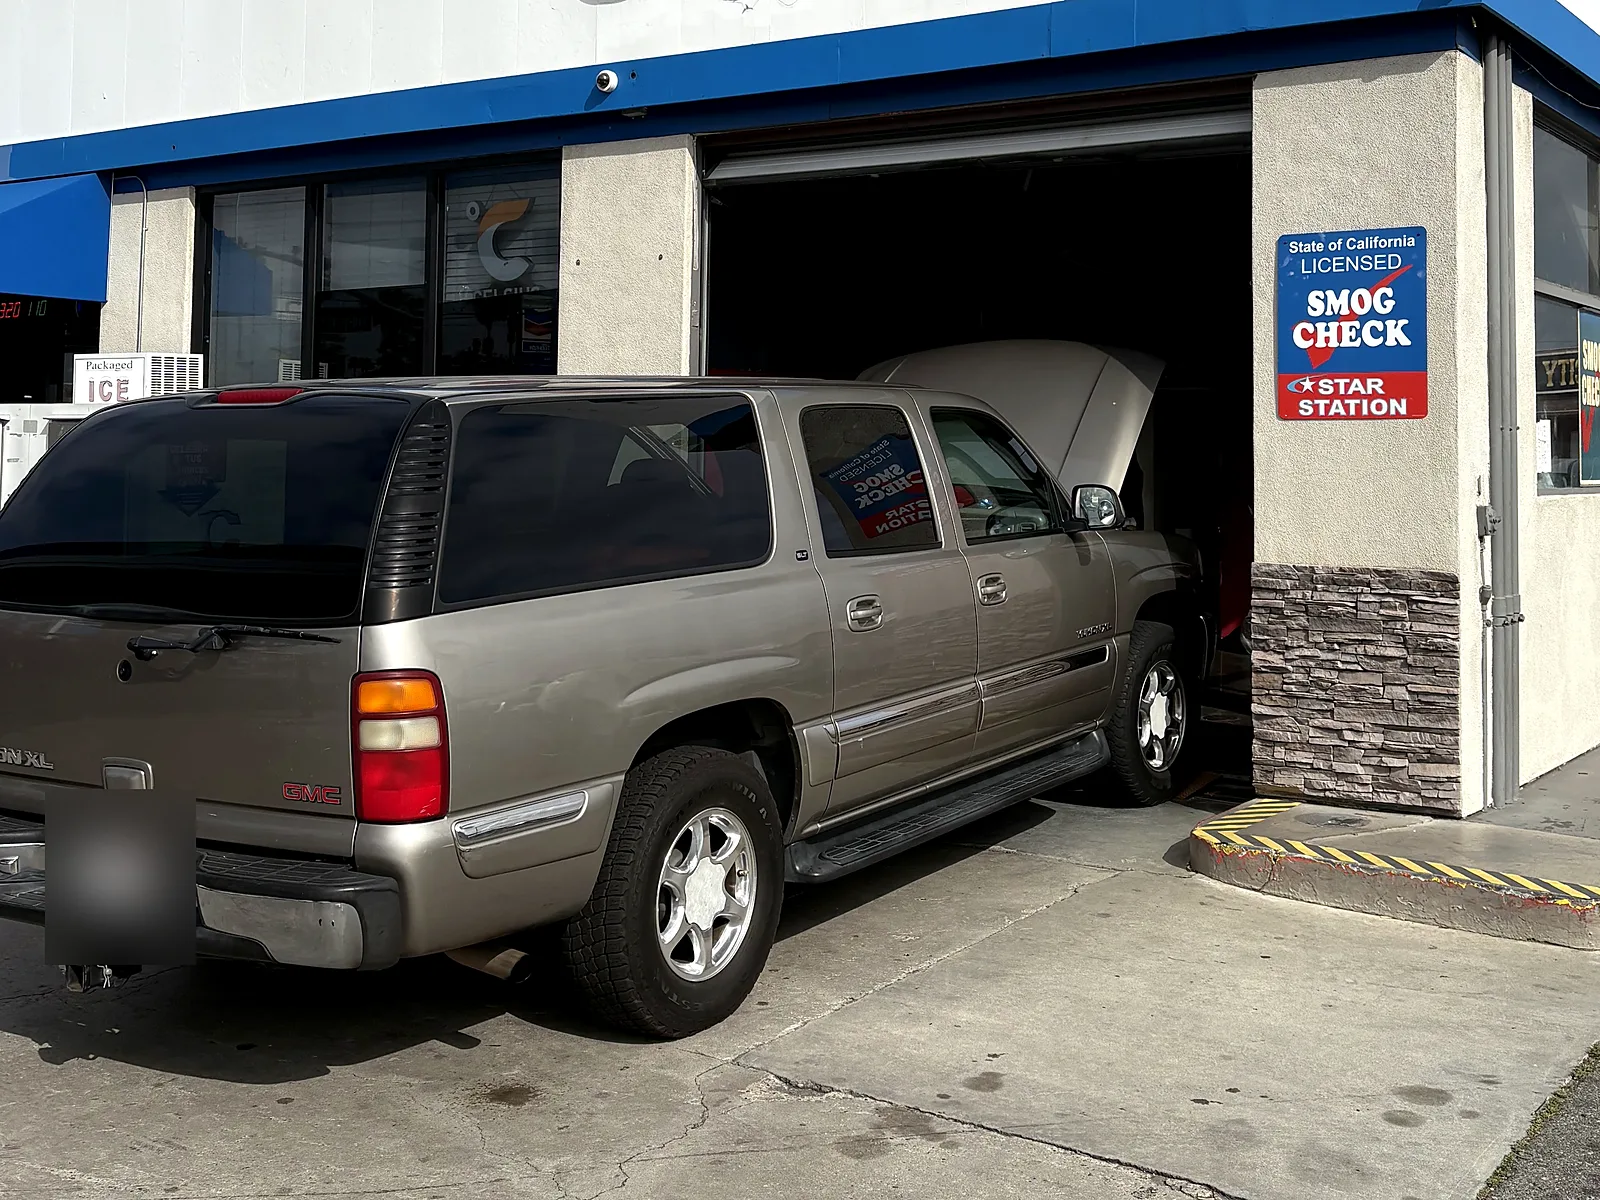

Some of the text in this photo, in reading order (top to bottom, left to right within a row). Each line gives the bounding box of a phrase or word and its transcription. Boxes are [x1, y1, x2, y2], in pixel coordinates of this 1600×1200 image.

[1289, 235, 1415, 253] State of California
[1301, 254, 1402, 274] LICENSED
[1307, 287, 1396, 317] SMOG
[1292, 319, 1412, 349] CHECK
[86, 360, 133, 371] Packaged
[1583, 339, 1600, 372] SMO
[88, 377, 129, 402] ICE
[1318, 378, 1385, 395] STAR
[1582, 374, 1600, 407] CHEC
[1299, 398, 1407, 416] STATION
[282, 782, 341, 805] GMC
